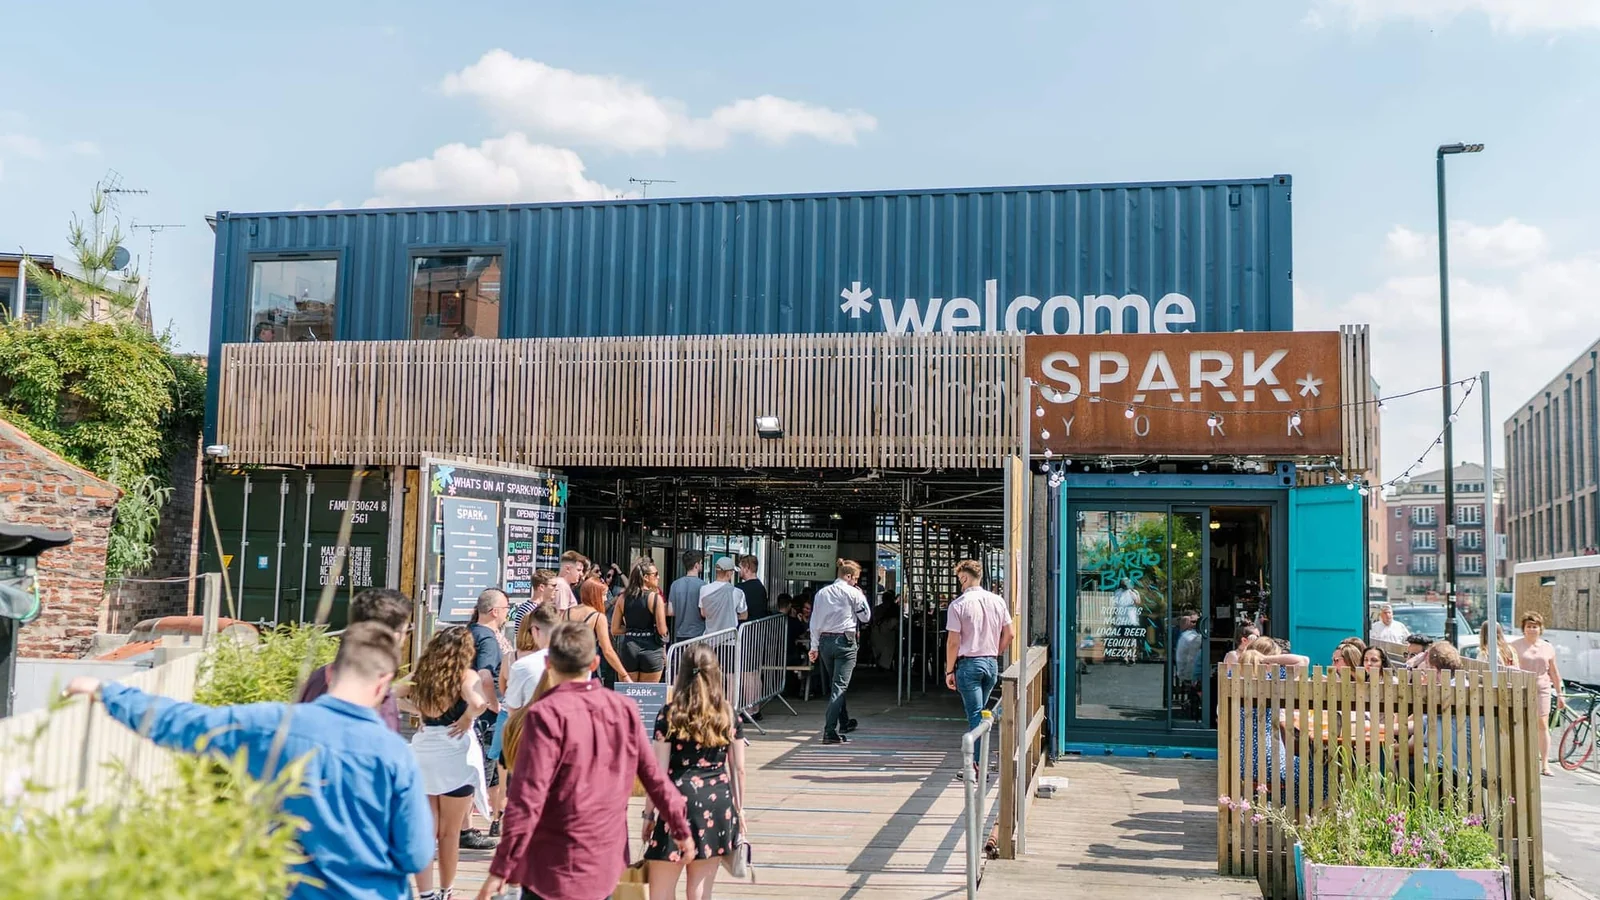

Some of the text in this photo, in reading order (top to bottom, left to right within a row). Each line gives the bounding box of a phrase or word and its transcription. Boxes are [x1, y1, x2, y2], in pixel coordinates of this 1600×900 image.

[878, 279, 1196, 335] welcome
[454, 477, 481, 489] WHAT'S
[483, 480, 494, 491] ON
[496, 483, 505, 493] AT
[329, 500, 349, 510] FAMU
[351, 500, 379, 511] 730624
[516, 509, 555, 521] OPENING TIMES
[515, 541, 532, 550] COFFEE
[320, 546, 335, 556] MAX
[1099, 568, 1144, 591] BAR
[1101, 606, 1143, 616] BURRIOS
[1103, 616, 1140, 626] NACHO
[1096, 627, 1147, 638] LOCAL BEER
[1103, 638, 1138, 648] TEQUILA
[1103, 648, 1138, 658] MEZCAL
[626, 688, 652, 696] SPARK
